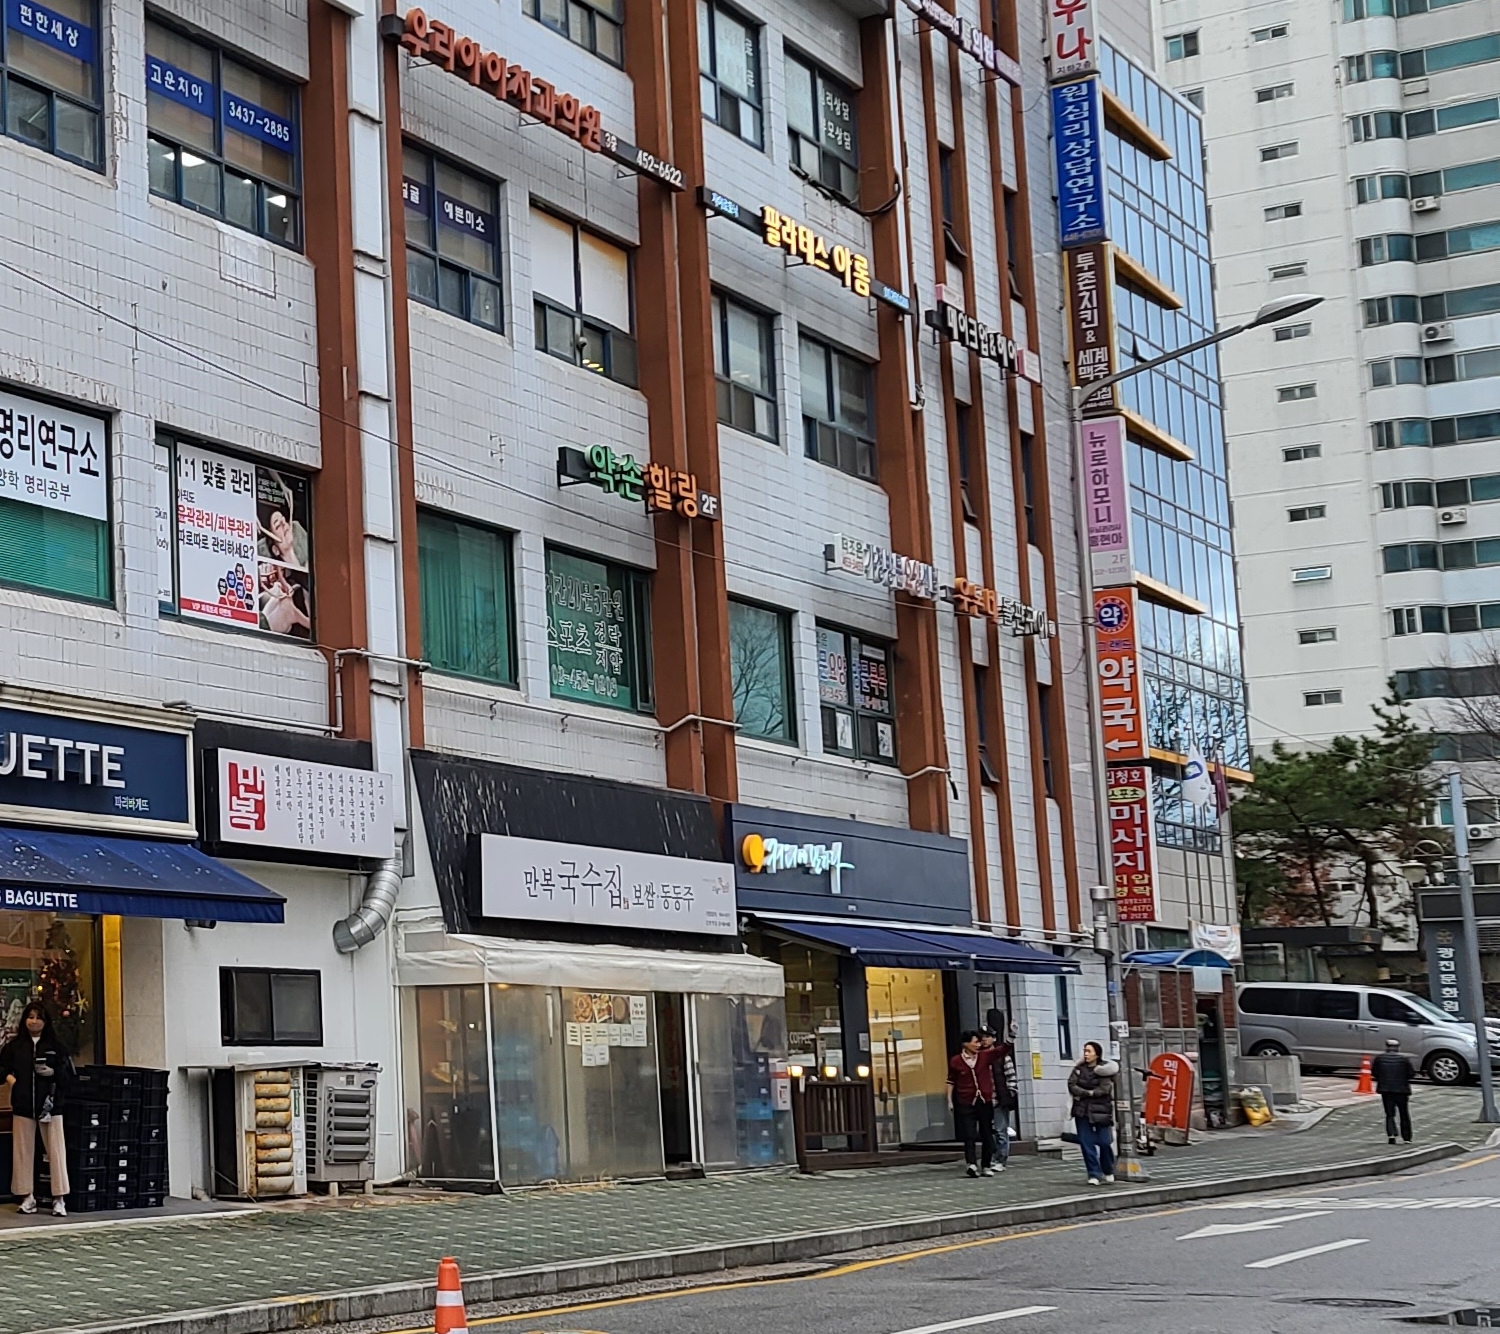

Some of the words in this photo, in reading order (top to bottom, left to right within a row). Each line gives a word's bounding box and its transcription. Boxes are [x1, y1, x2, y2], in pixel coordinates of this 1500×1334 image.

[19, 3, 80, 49] 편한세상
[149, 62, 204, 105] 고운치아
[228, 100, 291, 143] 3437-2885
[636, 148, 683, 188] 452-6622
[443, 200, 486, 233] 예쁜미소
[763, 204, 832, 271] 필라테스
[1077, 346, 1109, 367] 세계
[23, 474, 72, 503] 명리공부
[176, 454, 197, 481] 1:1
[201, 459, 227, 490] 맞춤
[230, 467, 254, 499] 관리
[701, 493, 719, 516] 2F
[211, 536, 255, 562] 관리하세요?
[1111, 553, 1127, 565] 2F
[1100, 606, 1121, 625] 약
[1099, 657, 1138, 734] 약국
[113, 794, 151, 813] 파리바게뜨
[1109, 803, 1148, 873] 마사지
[3, 889, 79, 909] BAGUETTE
[523, 859, 623, 912] 만복국수집
[1435, 946, 1461, 1013] 광진문화원
[1158, 1058, 1179, 1121] 멕시카나
